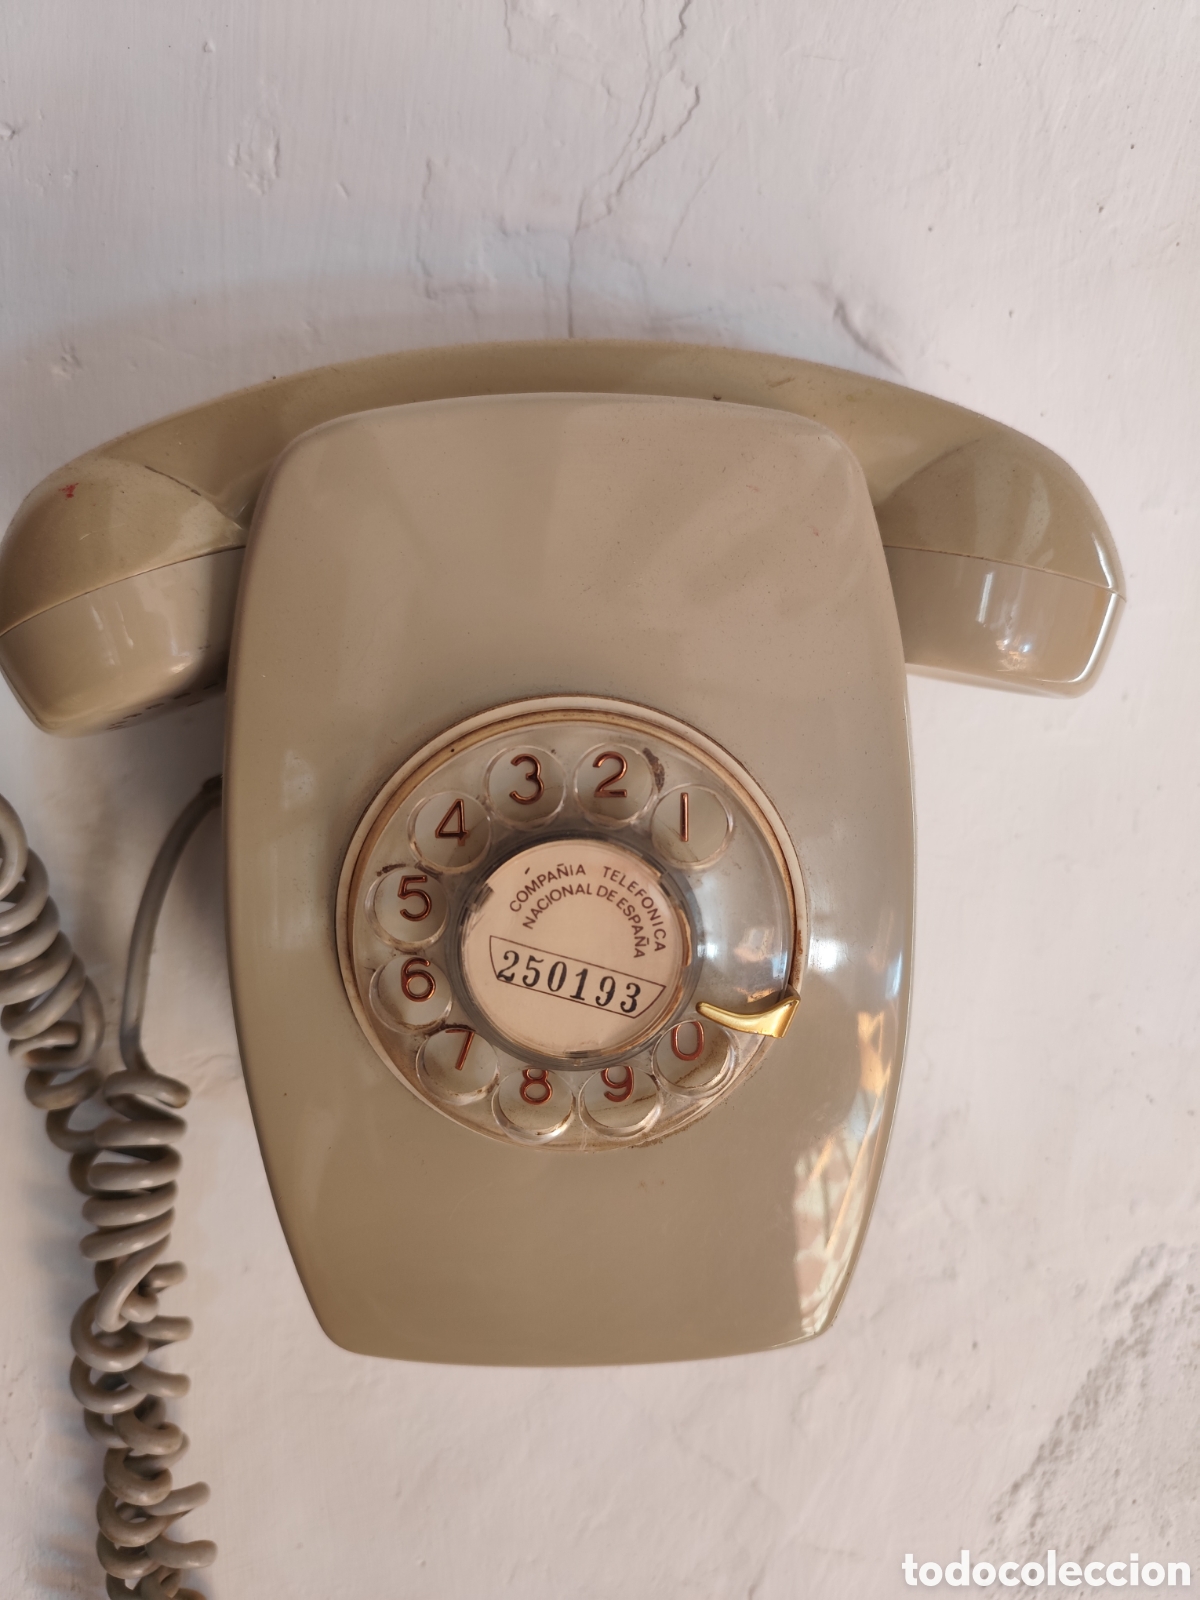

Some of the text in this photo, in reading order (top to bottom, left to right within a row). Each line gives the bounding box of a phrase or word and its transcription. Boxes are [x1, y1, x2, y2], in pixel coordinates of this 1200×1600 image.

[509, 753, 545, 805] 3
[592, 751, 628, 798] 2
[434, 798, 469, 845] 4
[680, 792, 689, 842] 1
[399, 875, 432, 922] 5
[509, 863, 667, 952] COMPAÑIA TELEFONICA
[522, 883, 650, 959] NACIONAL DE ESPAÑA
[400, 958, 437, 1003] 6
[497, 949, 642, 1014] 250193
[445, 1027, 477, 1071] 7
[670, 1021, 706, 1062] 0
[519, 1069, 553, 1105] 8
[600, 1065, 635, 1103] 9
